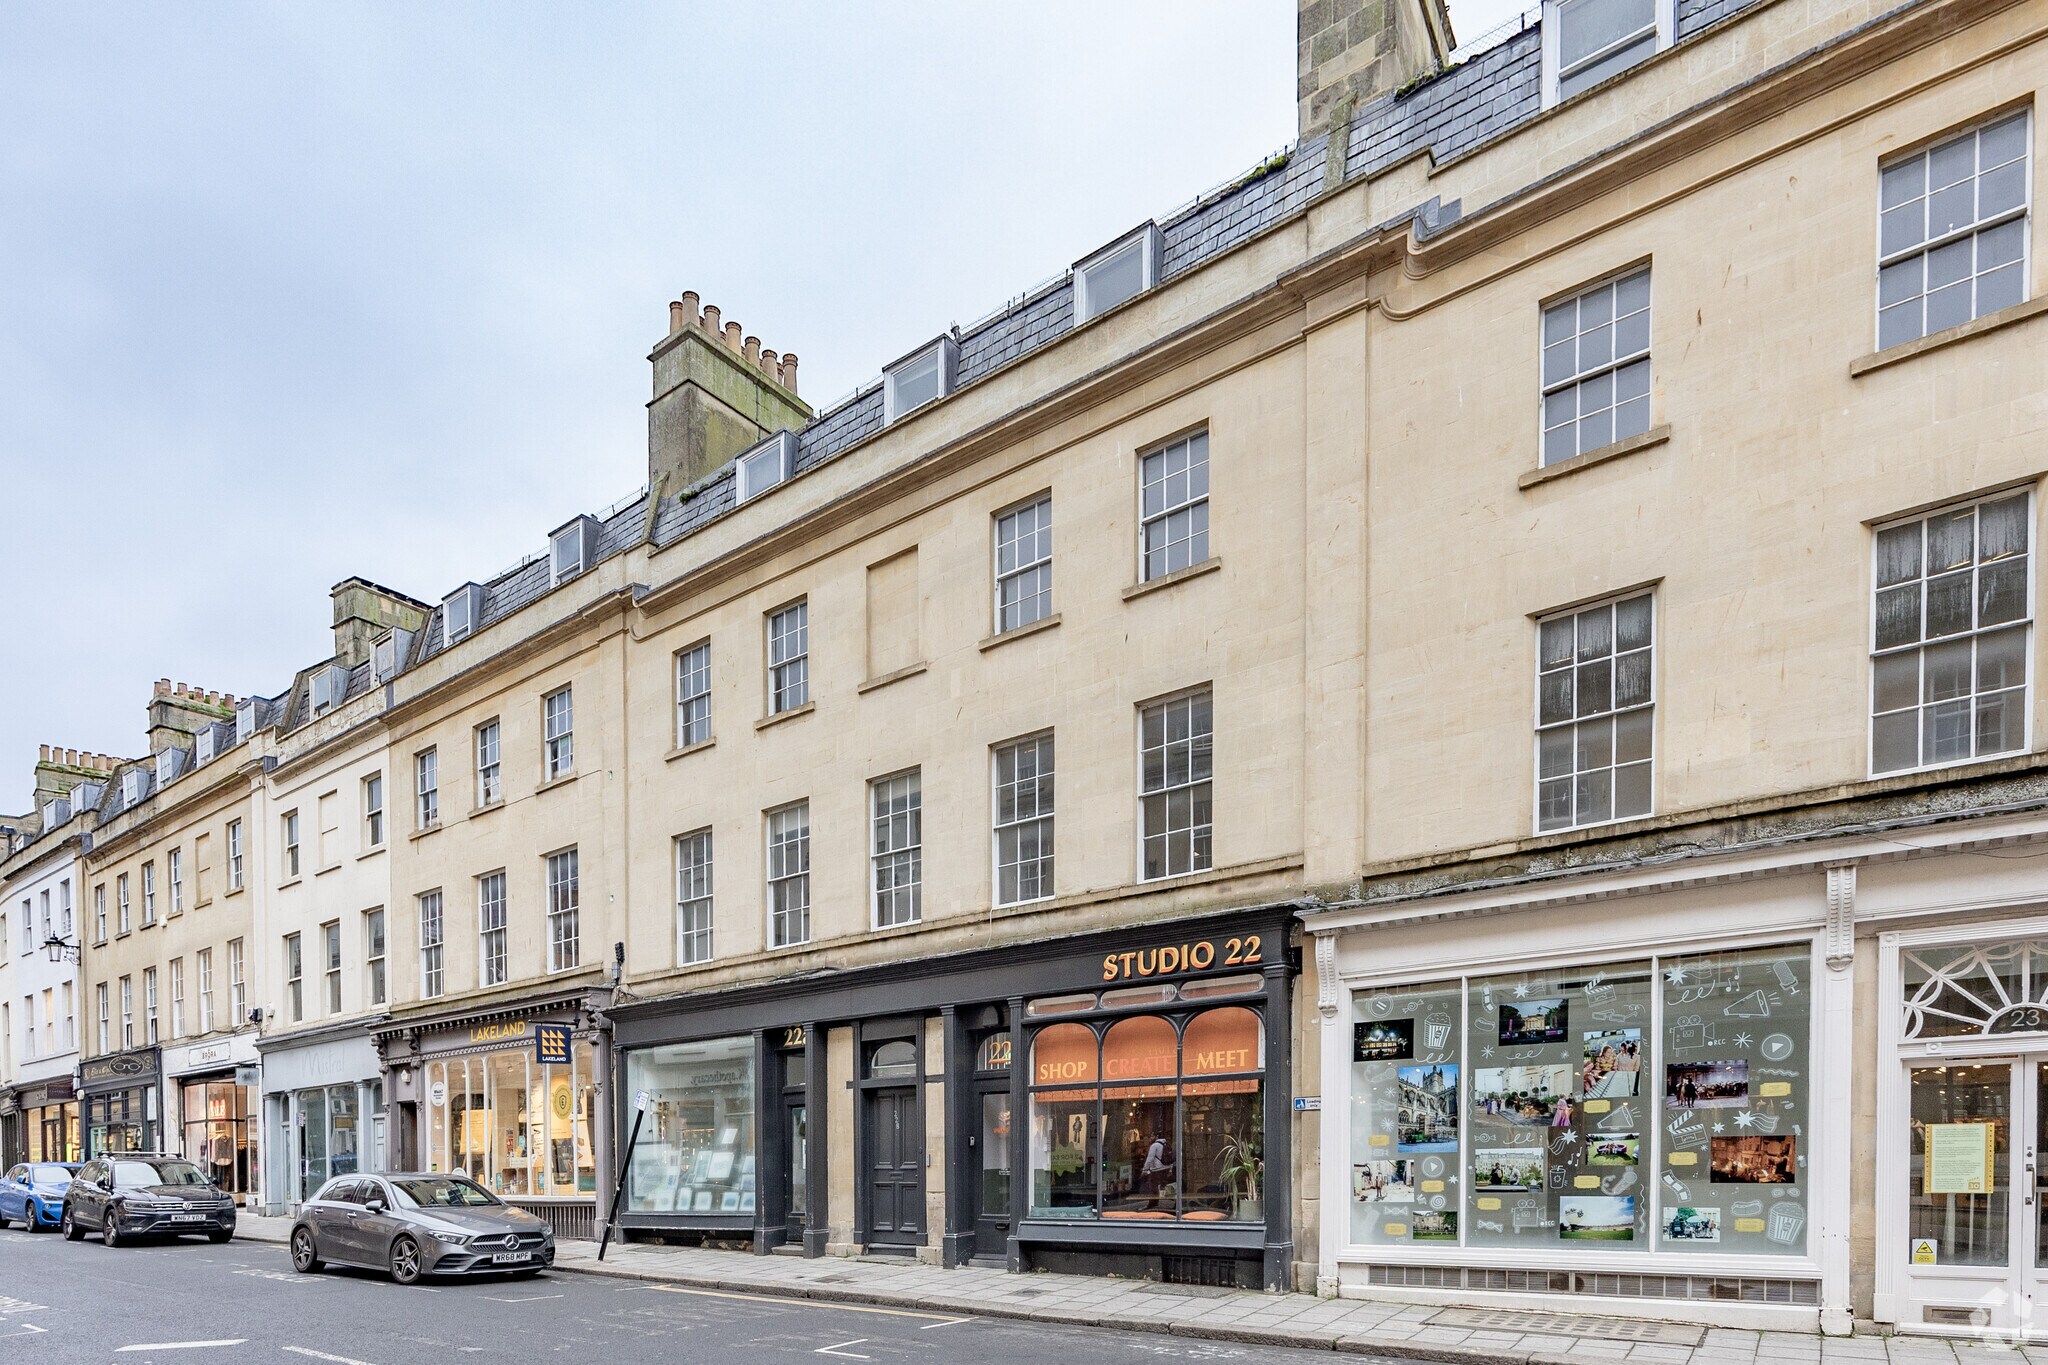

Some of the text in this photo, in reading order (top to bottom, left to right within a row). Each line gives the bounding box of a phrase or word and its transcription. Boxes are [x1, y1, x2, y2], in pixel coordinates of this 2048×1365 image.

[1103, 936, 1262, 980] STUDIO 22
[2010, 1009, 2041, 1027] 23
[469, 1021, 526, 1043] LAKELAND
[301, 1044, 345, 1077] Mistral
[988, 1041, 1011, 1065] 22
[1196, 1049, 1249, 1070] MEET
[1040, 1061, 1087, 1080] SHOP
[1106, 1056, 1173, 1076] CREATE
[496, 1253, 515, 1261] WR68
